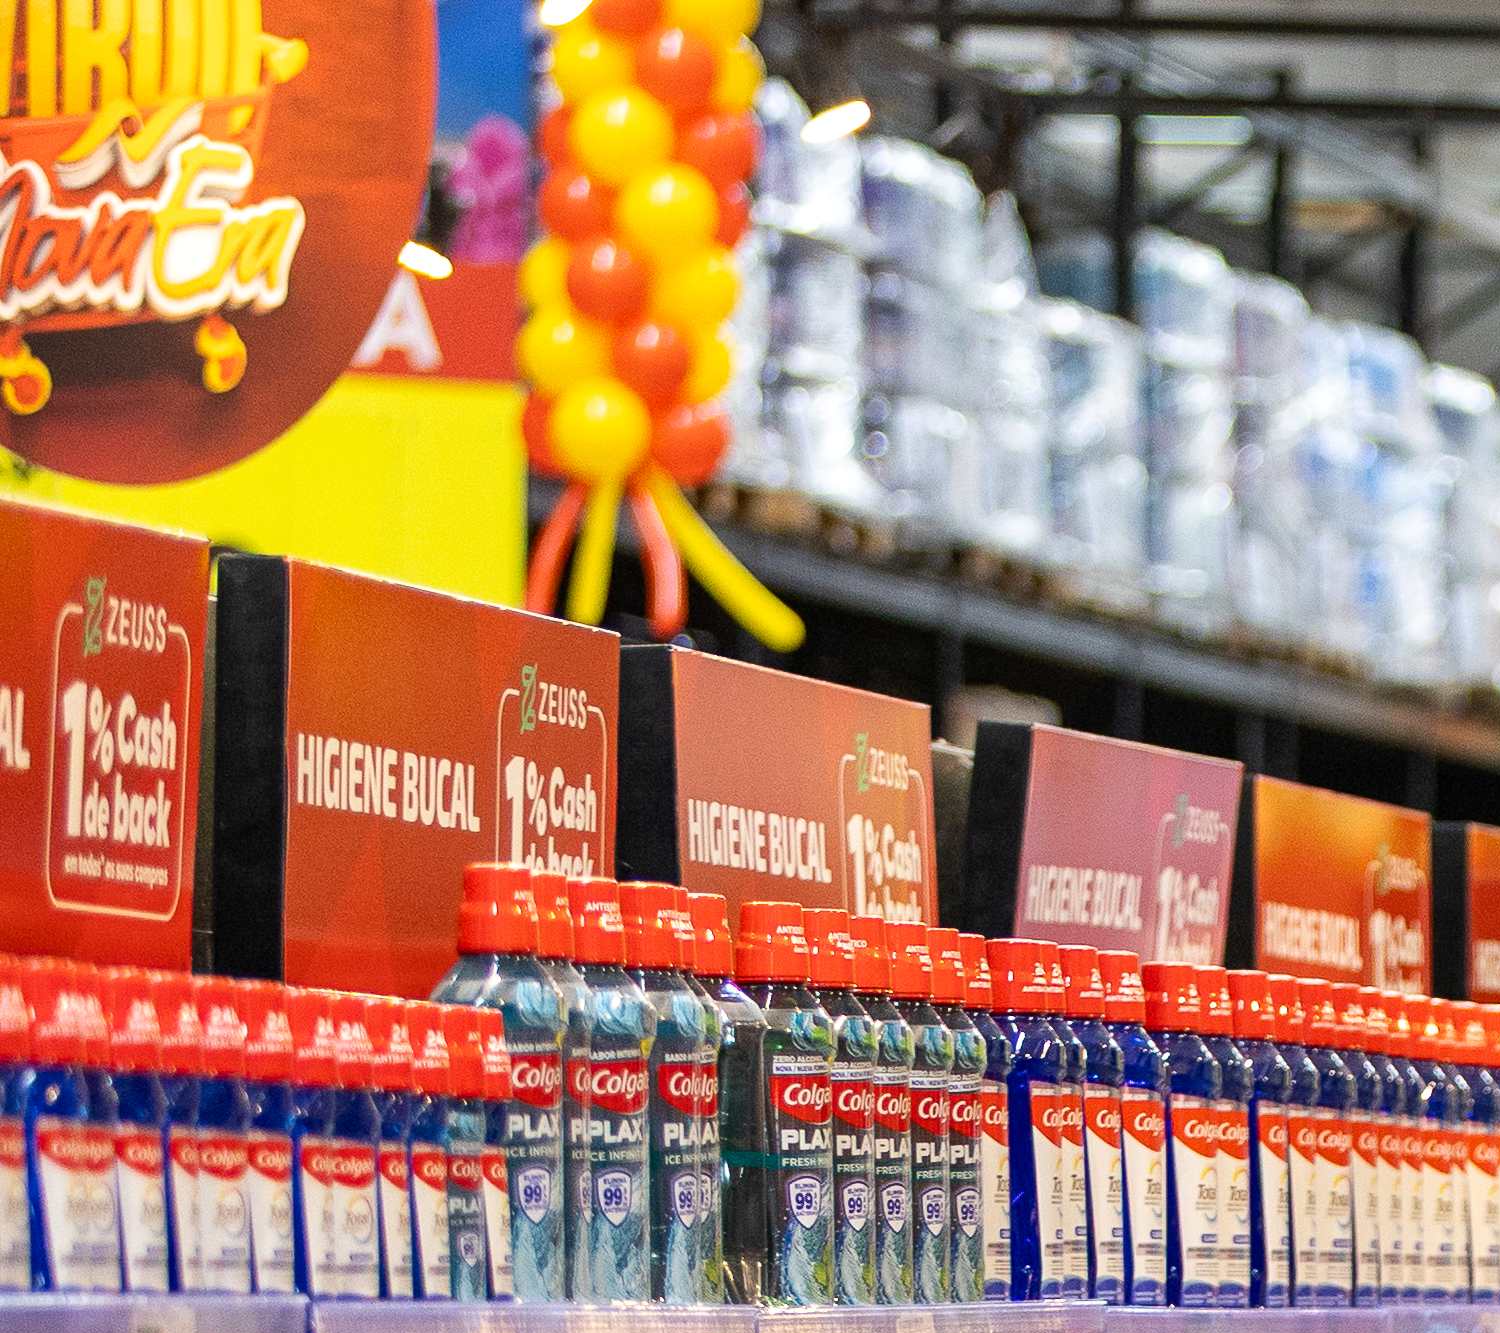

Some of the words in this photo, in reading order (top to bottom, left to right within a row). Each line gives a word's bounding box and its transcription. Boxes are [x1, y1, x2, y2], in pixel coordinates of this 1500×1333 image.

[106, 597, 168, 653] ZEUSS
[538, 681, 588, 730] ZEUSS
[63, 681, 115, 838] 1%
[116, 694, 178, 770] Cash
[297, 733, 399, 818] HIGIENE
[402, 752, 481, 833] BUCAL
[868, 747, 909, 791] ZEUSS
[84, 779, 110, 840] de
[113, 771, 172, 849] back
[549, 766, 598, 833] Cash
[688, 798, 767, 873] HIGIENE
[768, 812, 833, 884] BUCAL
[882, 823, 922, 883] Cash
[1028, 865, 1093, 926] HIGIENE
[1092, 868, 1143, 931] BUCAL
[591, 1120, 643, 1143] PLAX
[782, 1158, 816, 1167] FRESH
[795, 1192, 814, 1209] 99
[848, 1198, 862, 1213] 99
